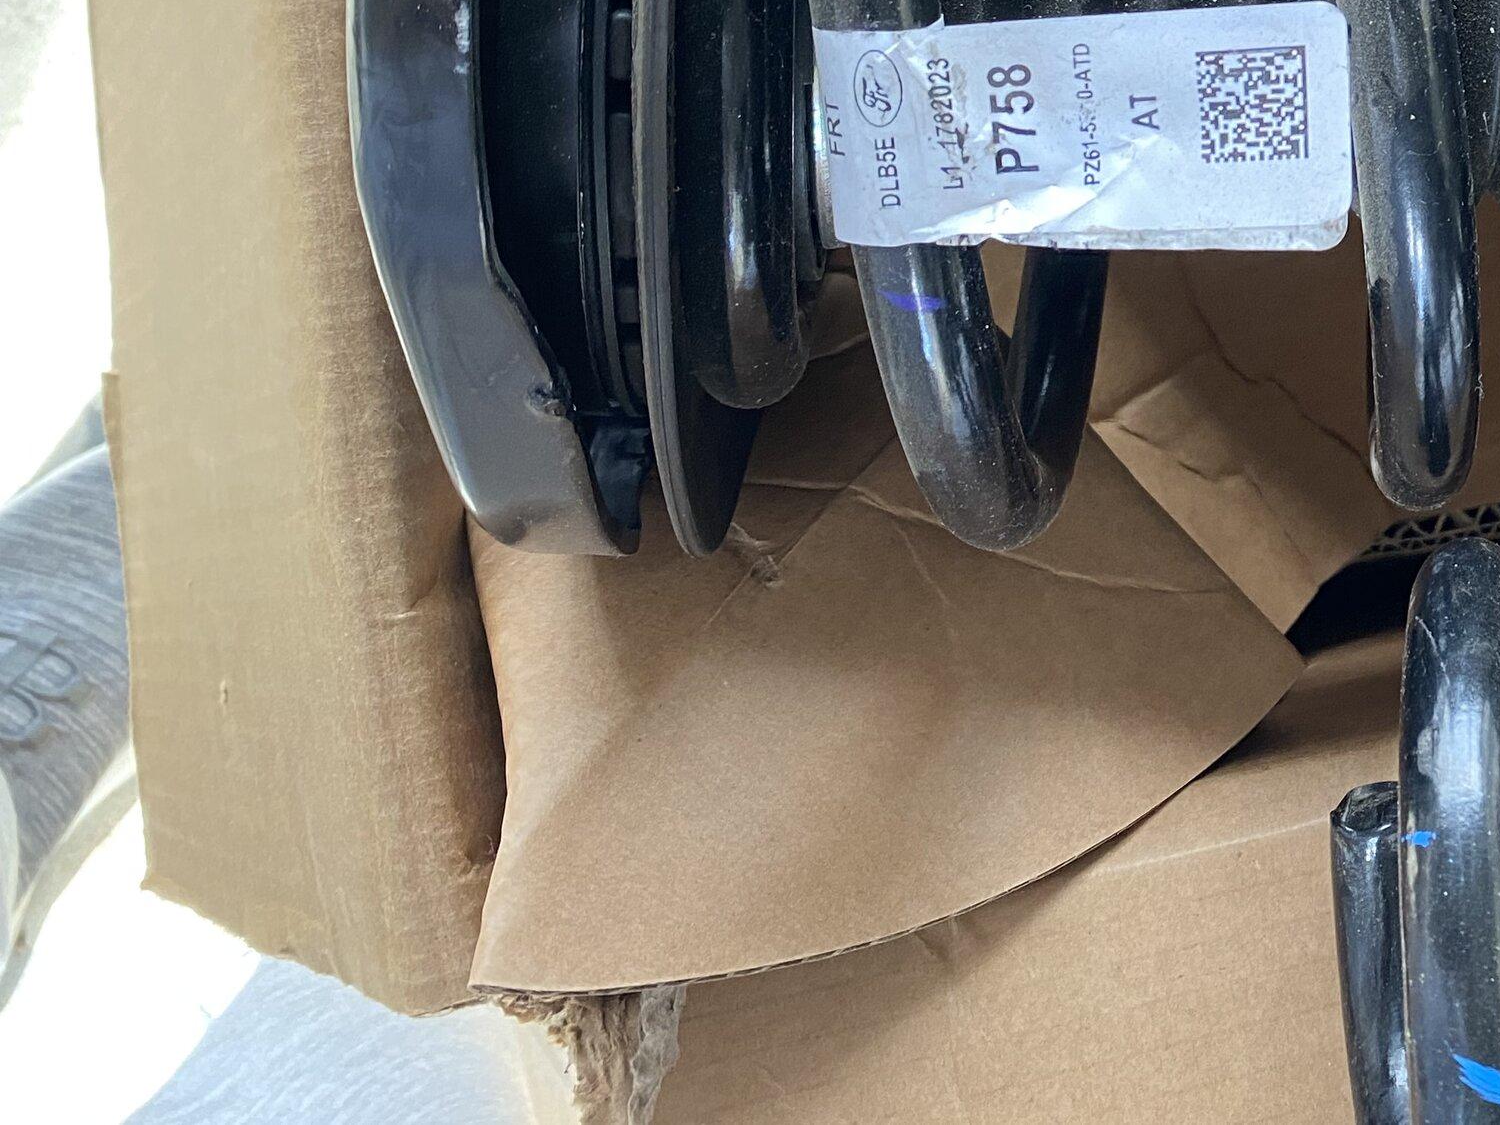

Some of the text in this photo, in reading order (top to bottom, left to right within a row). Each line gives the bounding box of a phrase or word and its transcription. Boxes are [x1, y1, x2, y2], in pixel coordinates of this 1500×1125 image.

[825, 98, 847, 156] FRT
[985, 63, 1039, 175] P758
[1072, 43, 1101, 186] PZ61-50-ATD
[1129, 94, 1161, 131] AT
[876, 137, 902, 207] DLB5E
